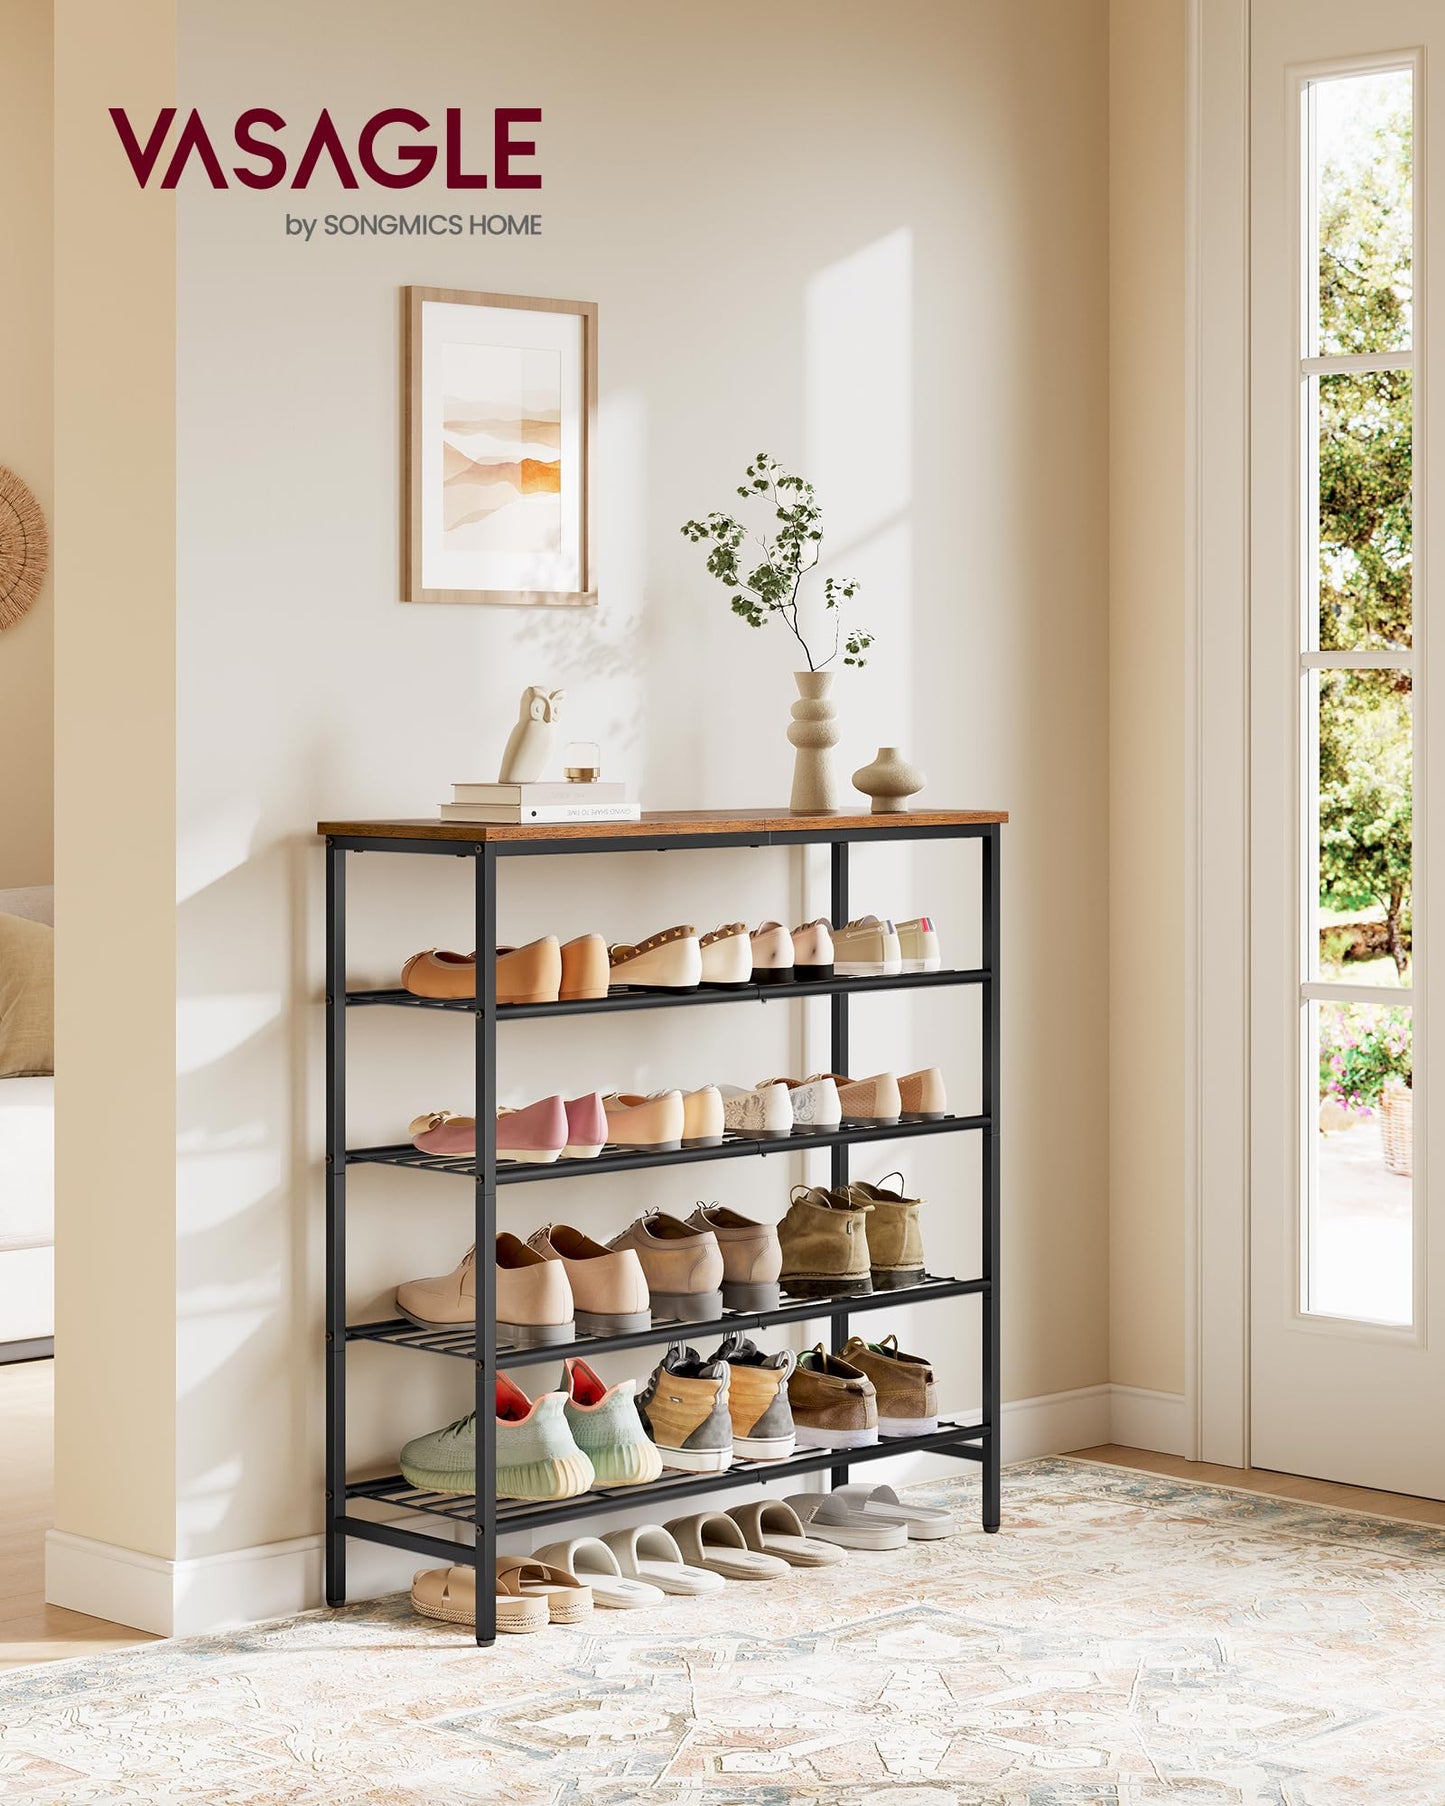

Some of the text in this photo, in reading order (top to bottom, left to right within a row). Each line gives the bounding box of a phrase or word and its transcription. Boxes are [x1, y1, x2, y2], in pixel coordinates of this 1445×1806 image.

[567, 808, 632, 817] GIVING SHAPE TO TIME
